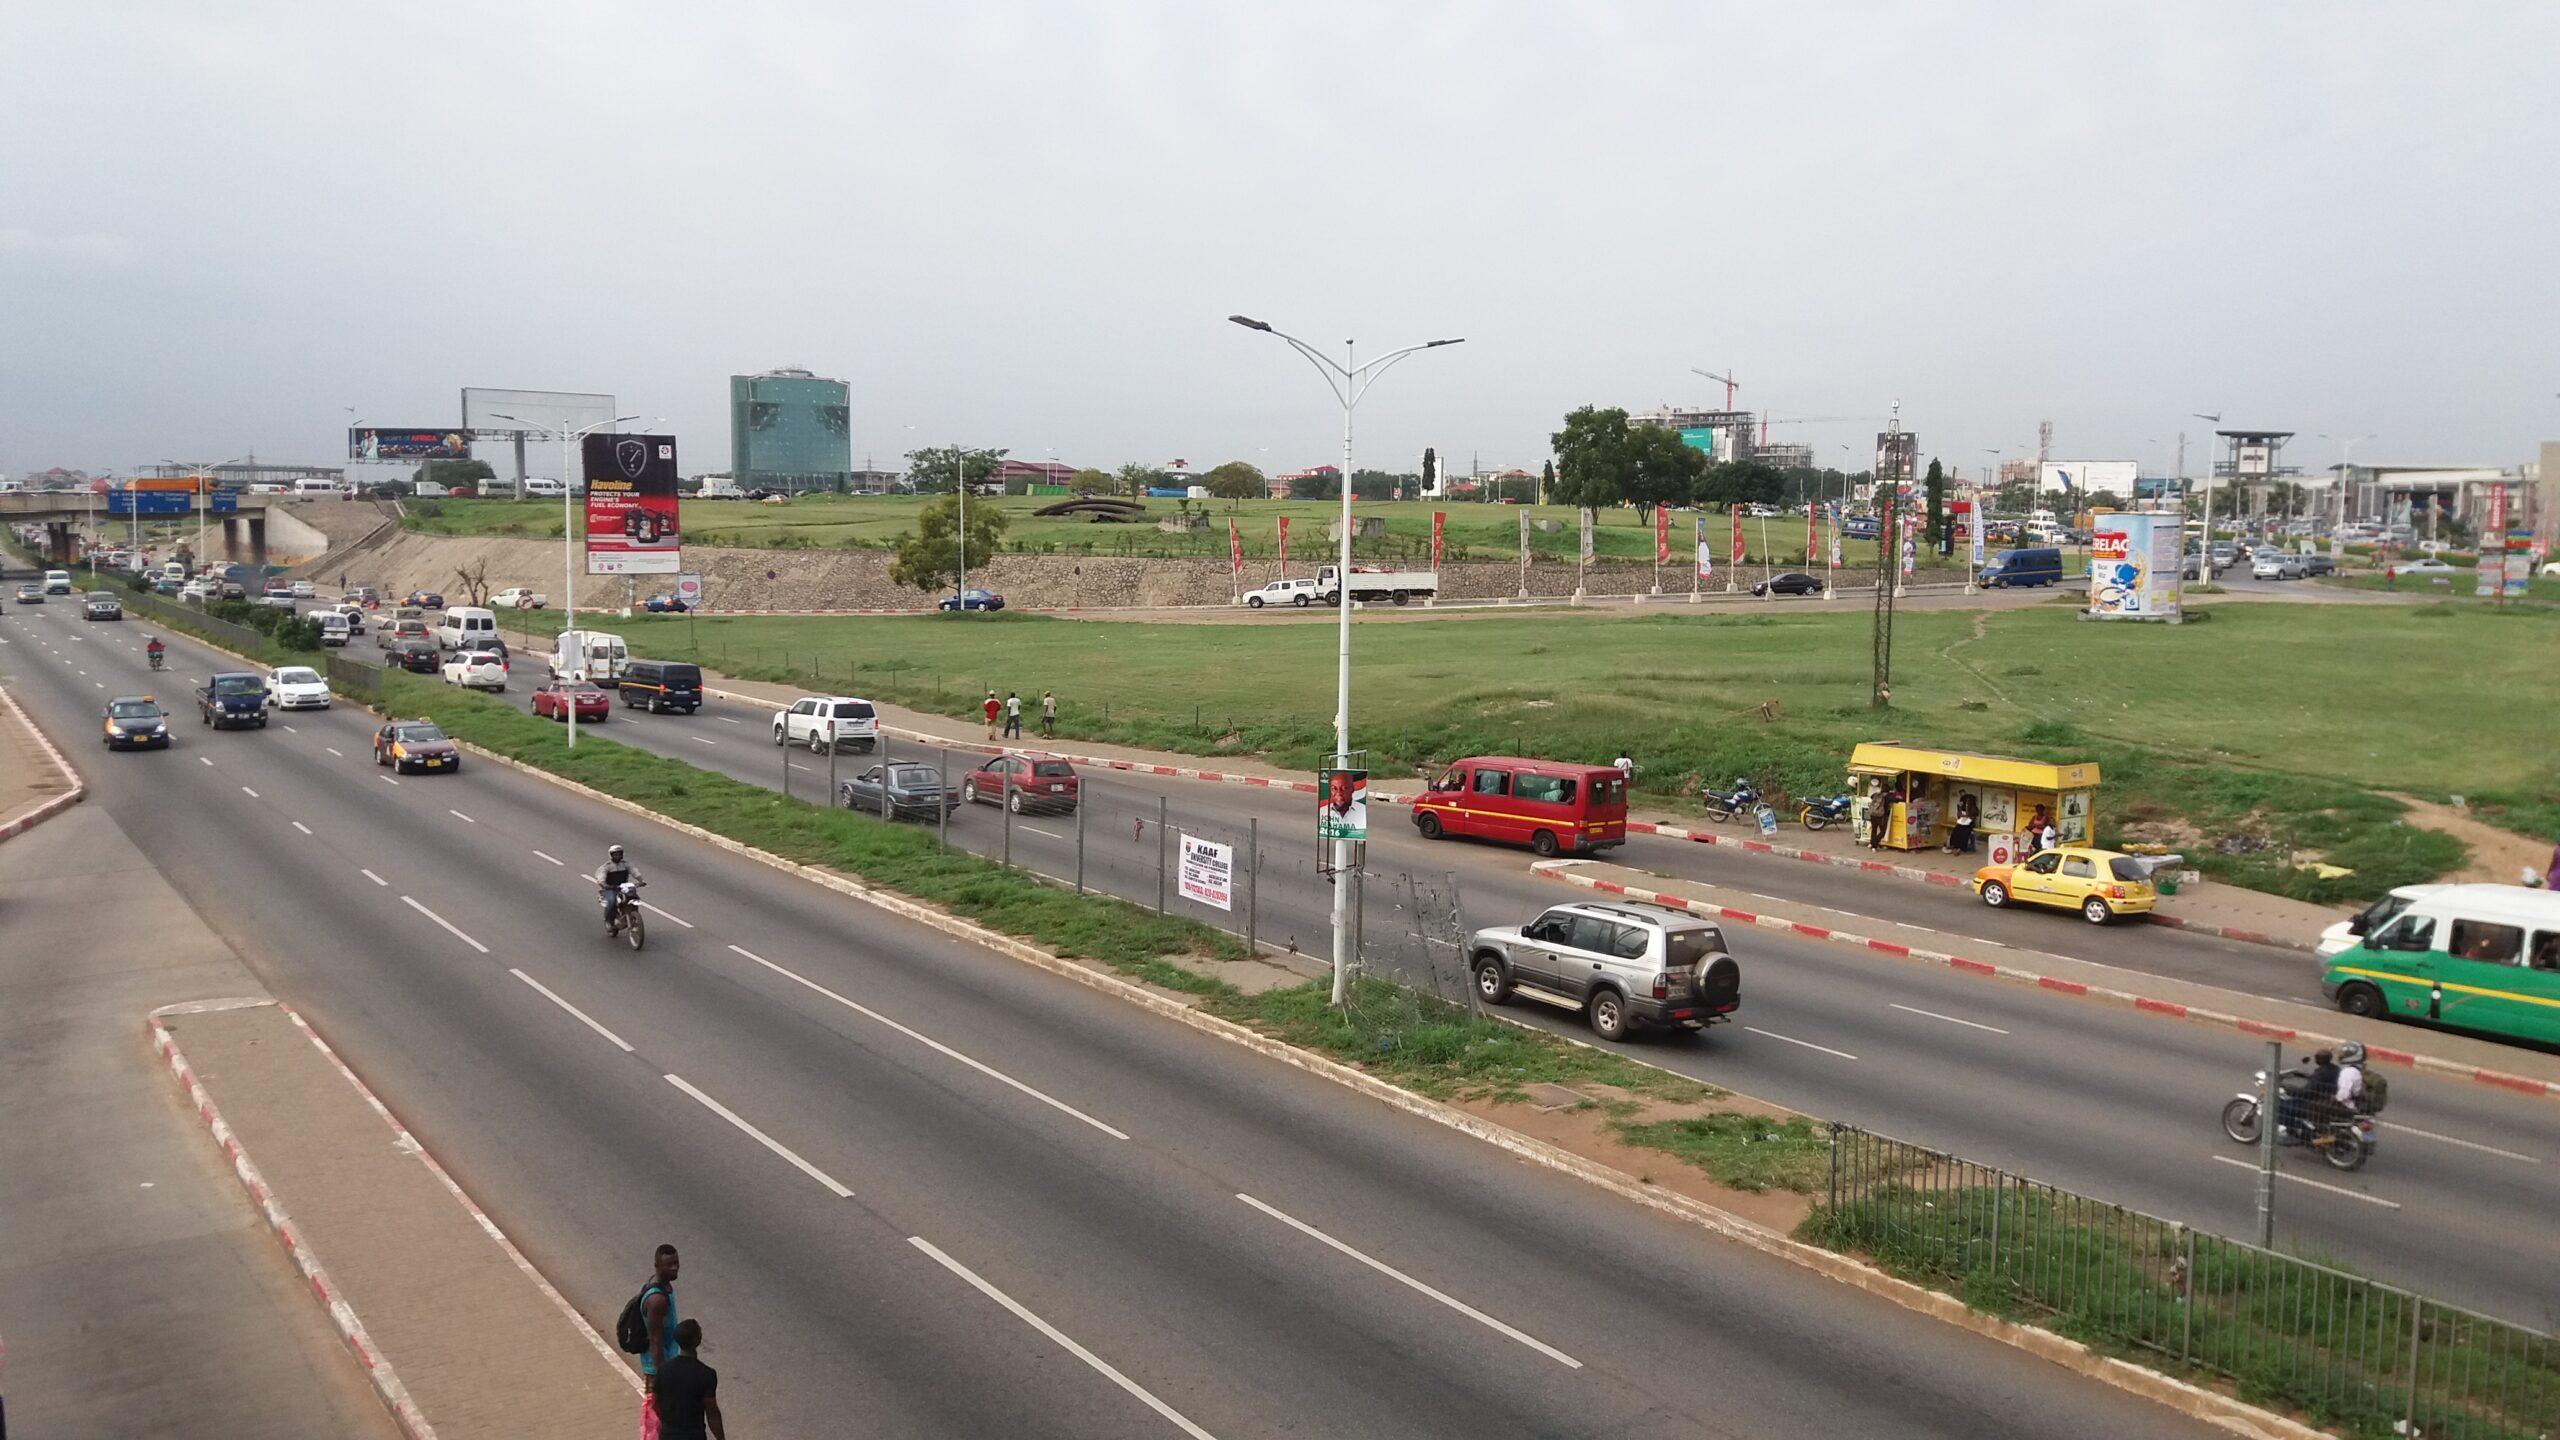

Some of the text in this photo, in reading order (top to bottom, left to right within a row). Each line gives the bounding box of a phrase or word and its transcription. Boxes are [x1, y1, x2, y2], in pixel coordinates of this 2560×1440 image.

[591, 480, 633, 490] Havoline
[2092, 538, 2130, 552] RELAC
[1198, 844, 1218, 858] KAAF
[1212, 859, 1229, 870] COLLEGE
